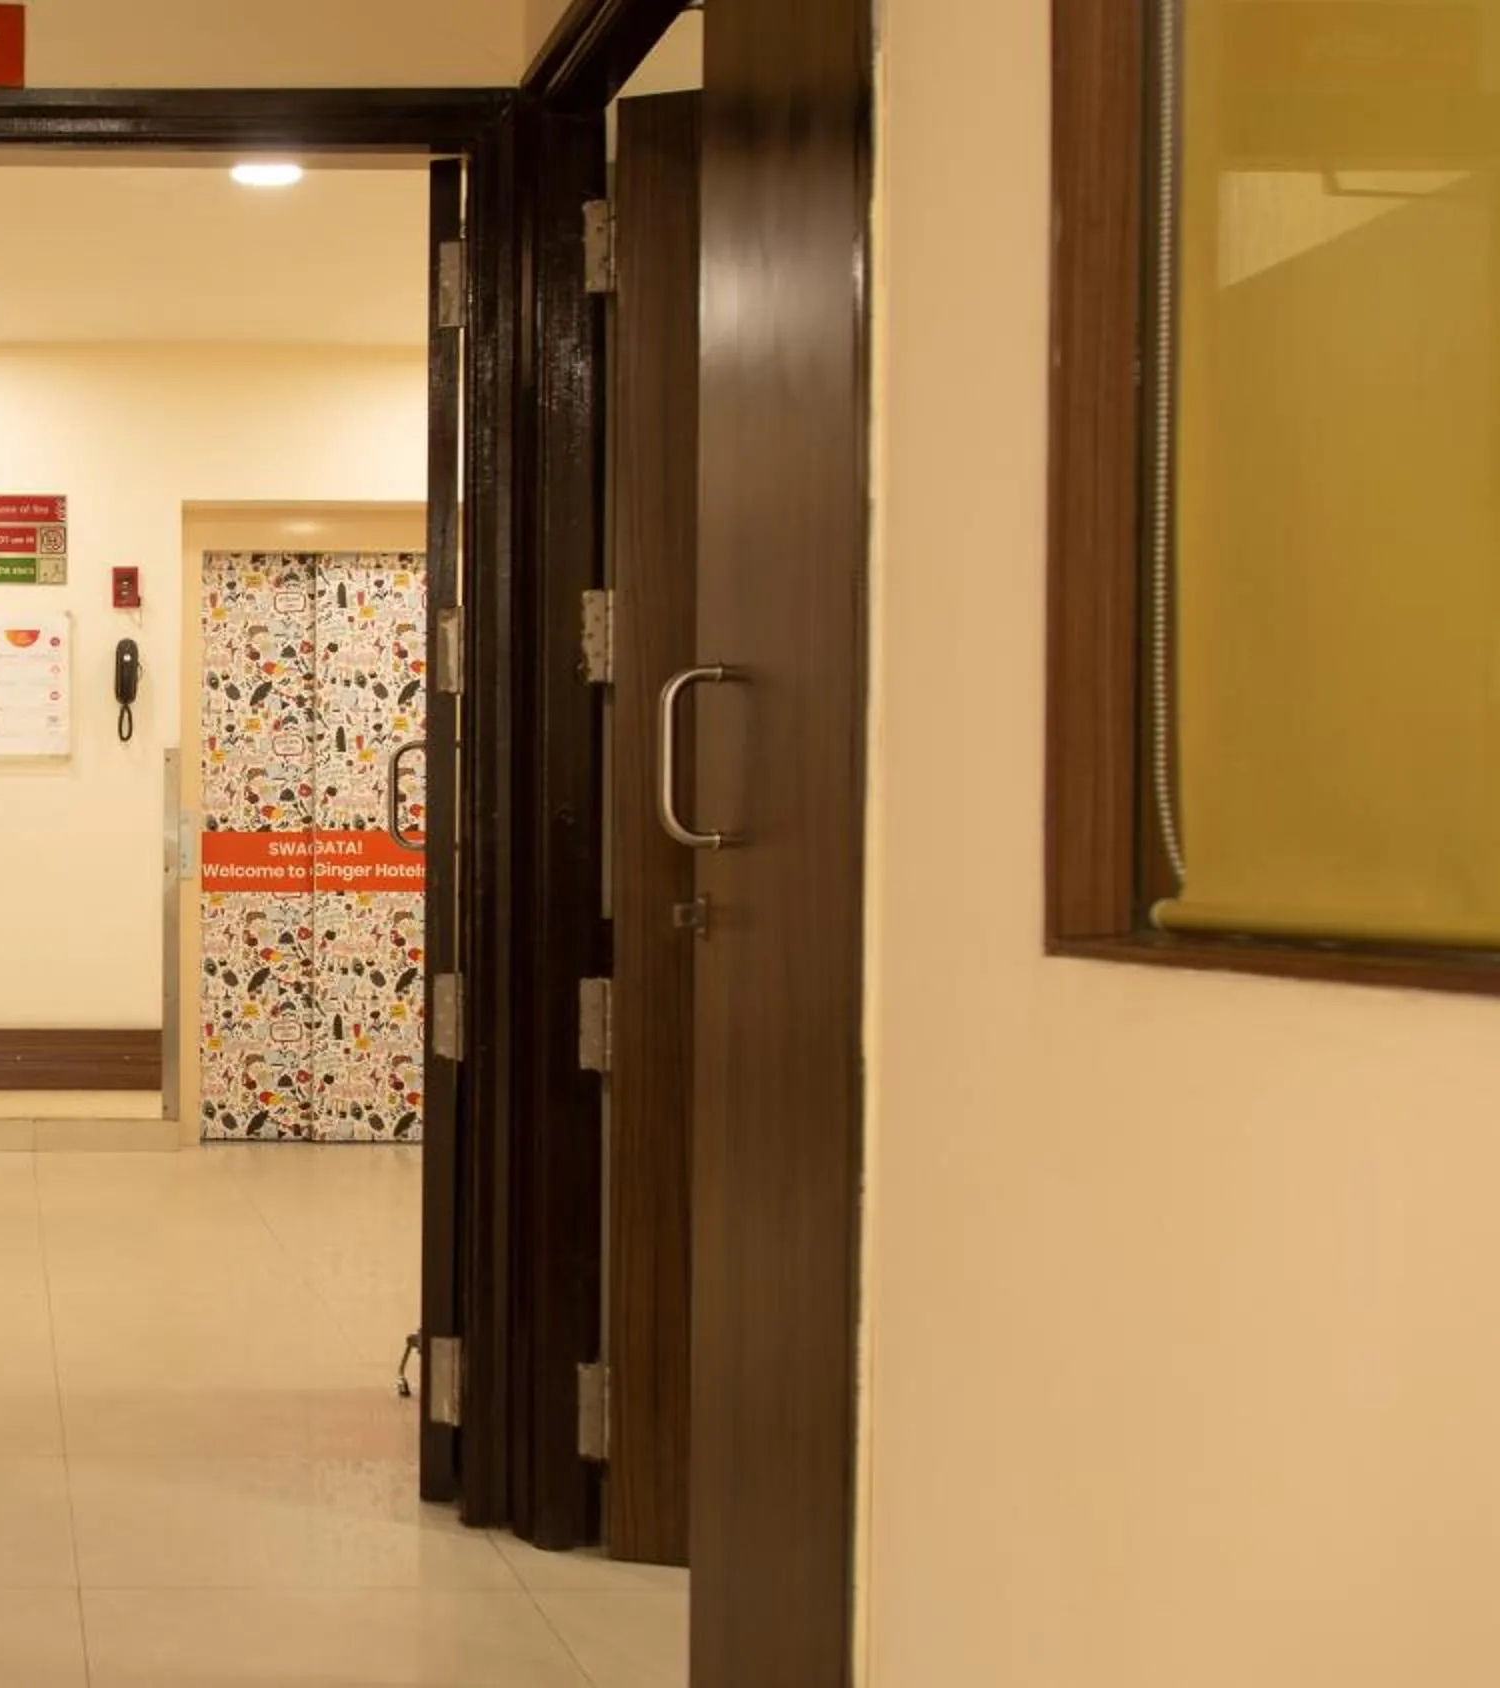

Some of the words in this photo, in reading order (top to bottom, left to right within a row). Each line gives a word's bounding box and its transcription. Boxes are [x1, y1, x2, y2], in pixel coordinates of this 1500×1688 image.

[268, 840, 363, 857] SWAGATA!
[203, 862, 284, 878] Welcome
[287, 864, 305, 878] to
[309, 862, 372, 881] Ginger
